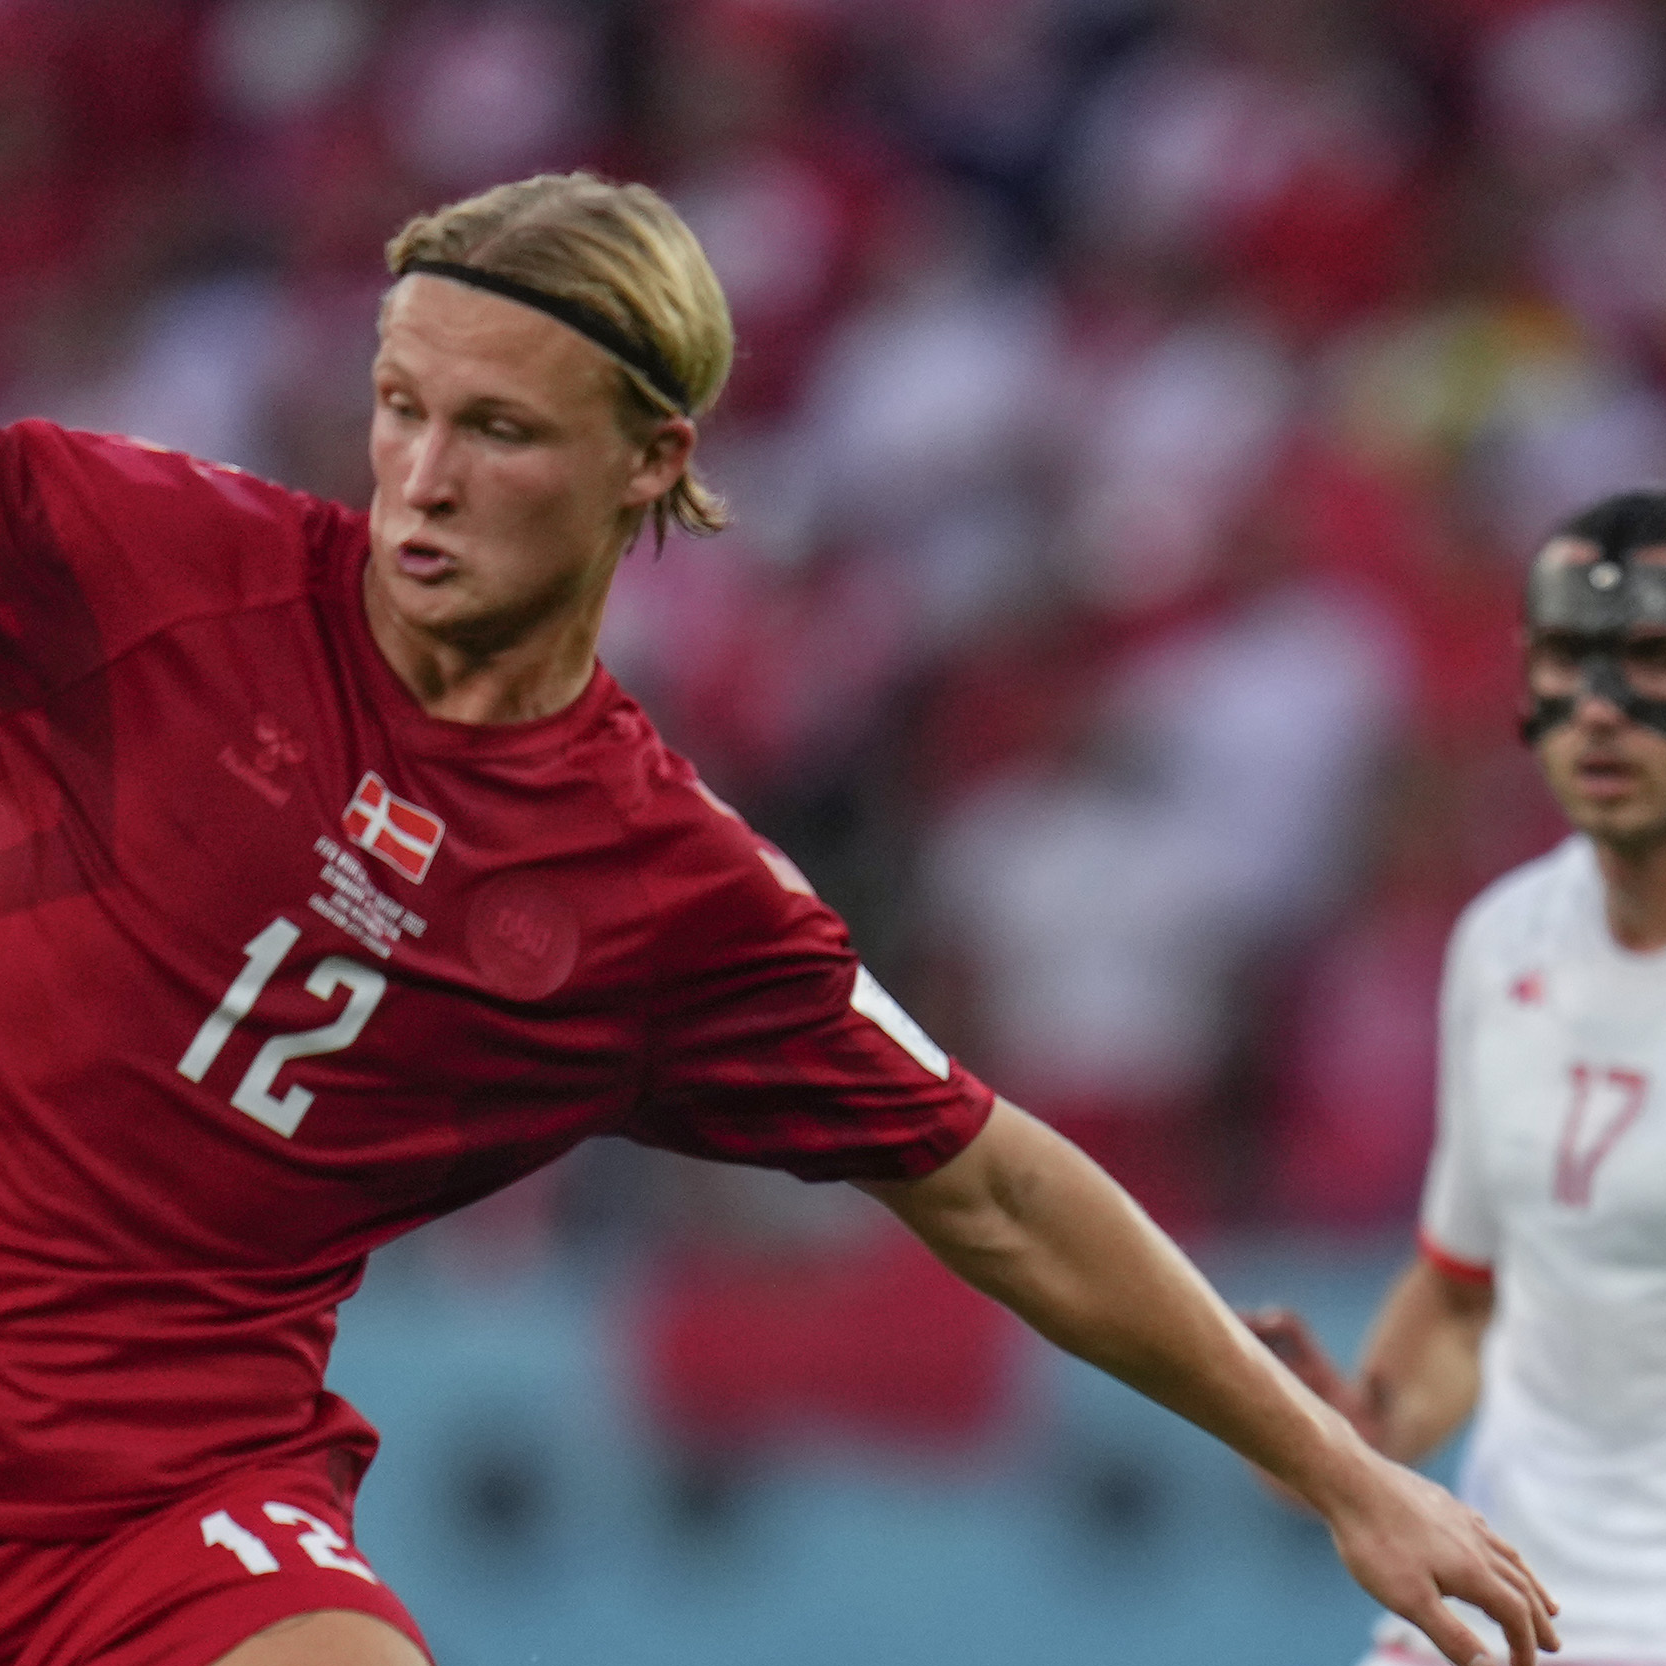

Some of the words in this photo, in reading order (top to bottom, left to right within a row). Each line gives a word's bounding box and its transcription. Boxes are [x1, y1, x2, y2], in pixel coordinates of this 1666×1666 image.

[177, 916, 388, 1139] 12
[1552, 1062, 1647, 1208] 17
[199, 1500, 378, 1586] 12
